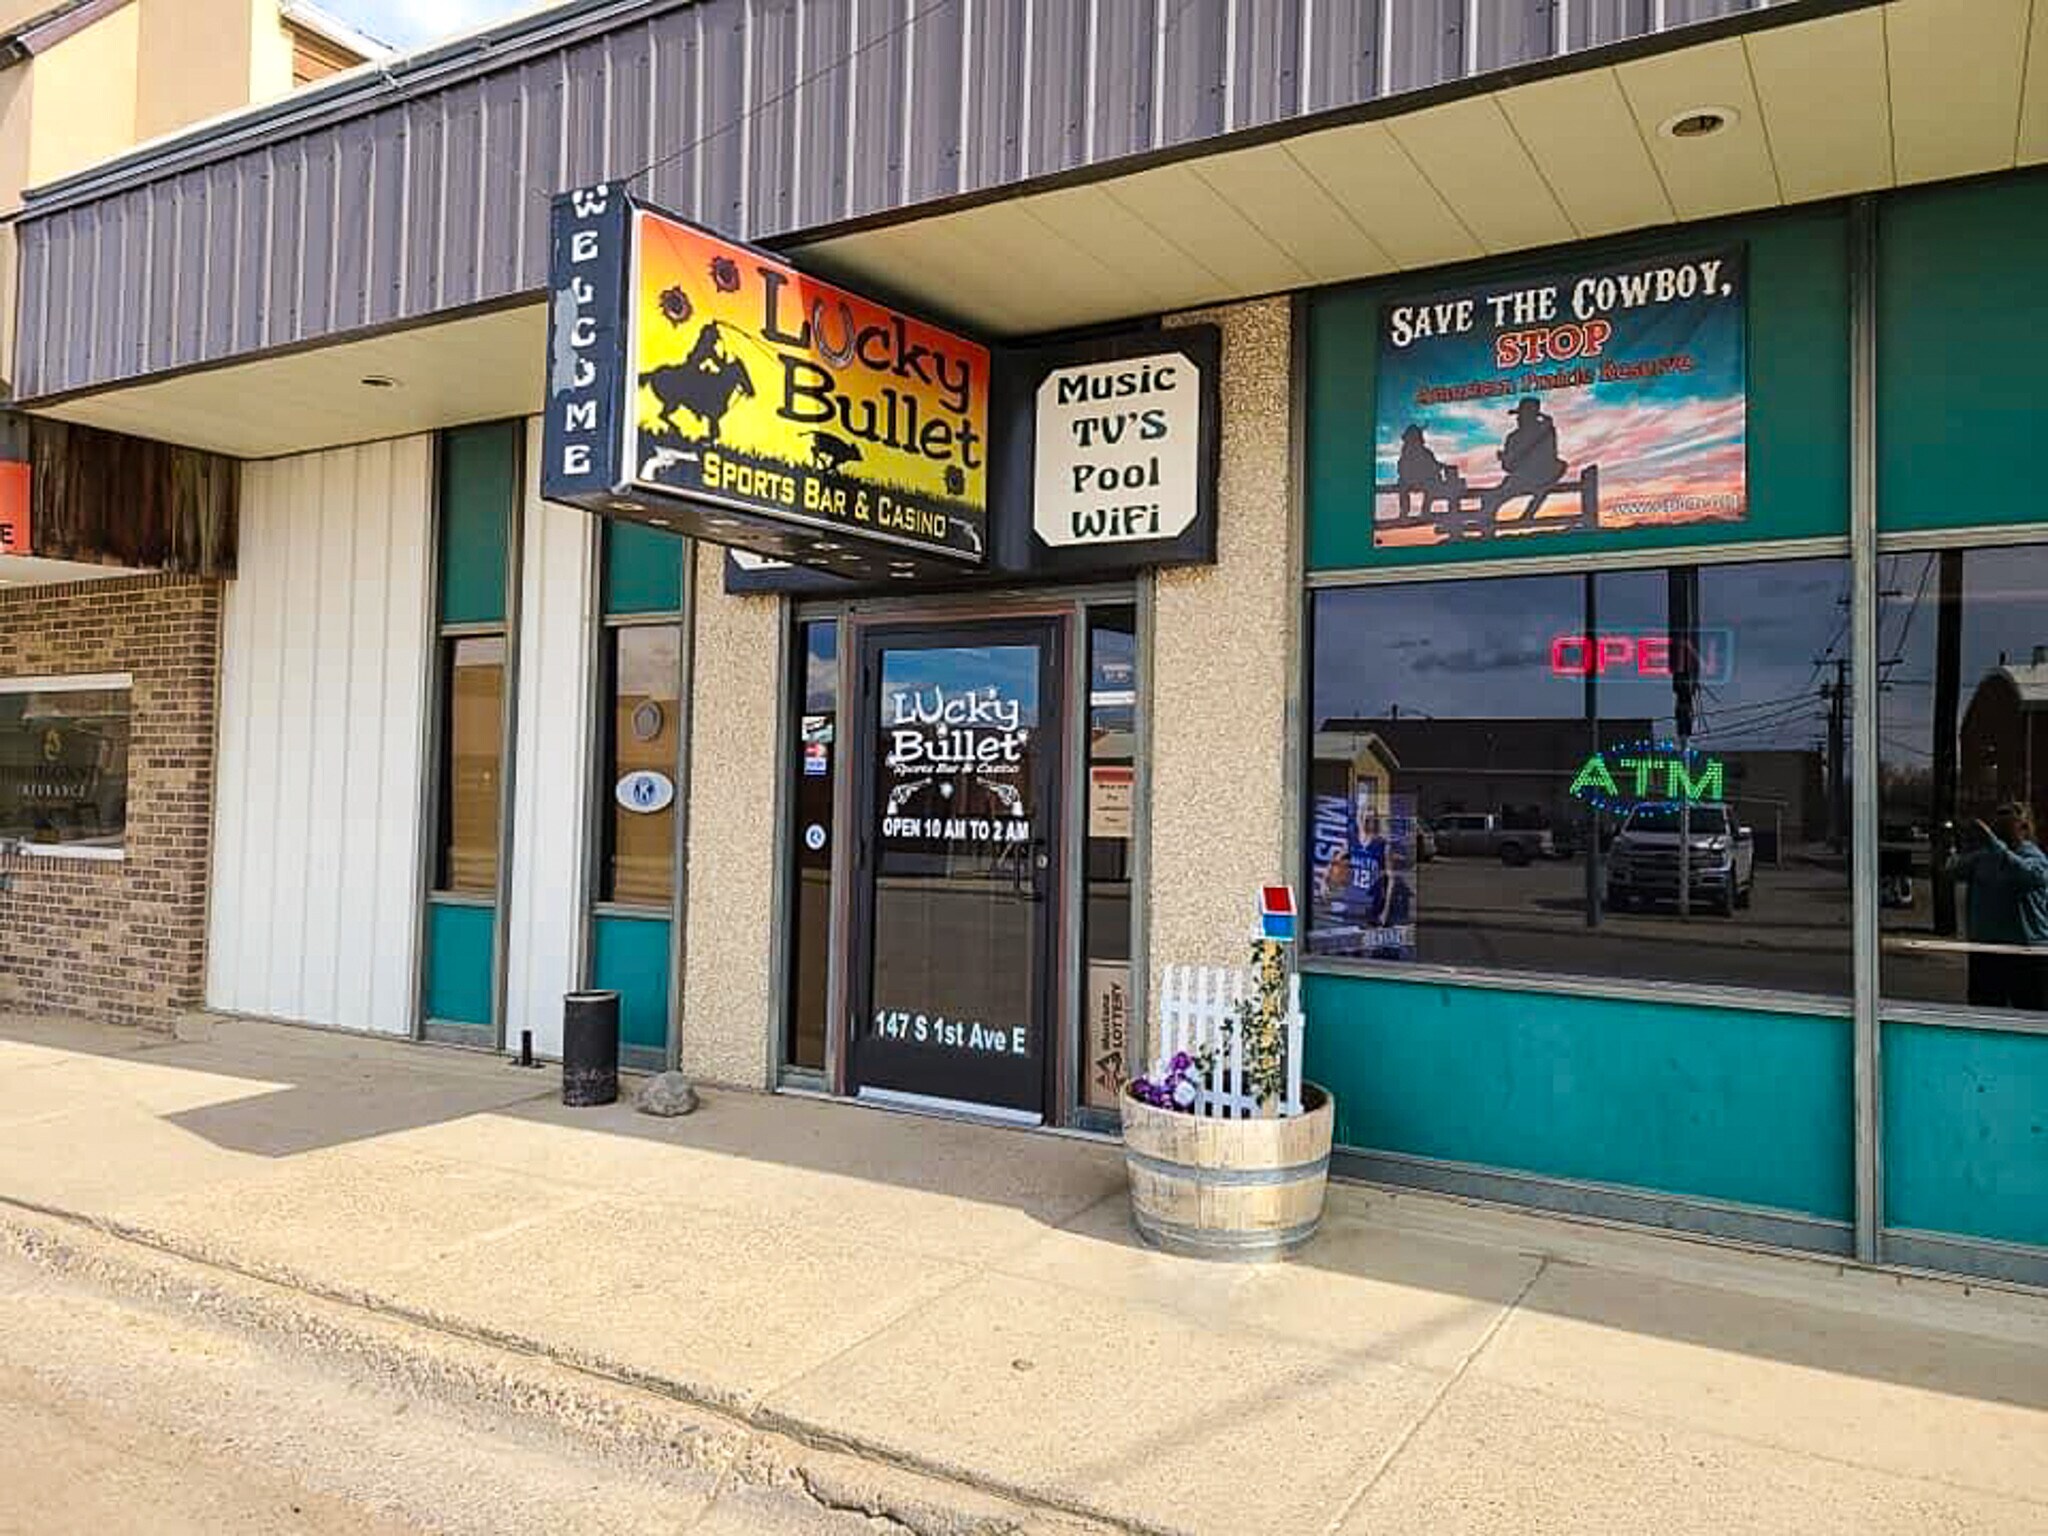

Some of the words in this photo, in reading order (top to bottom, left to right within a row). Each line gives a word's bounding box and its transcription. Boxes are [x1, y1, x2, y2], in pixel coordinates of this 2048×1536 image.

[1488, 288, 1556, 327] THE
[1497, 321, 1610, 367] STOP
[1058, 365, 1176, 404] Music
[775, 353, 982, 471] Bullet
[1072, 409, 1168, 447] TV'S
[1073, 456, 1160, 493] Pool
[854, 493, 870, 521] &
[1072, 504, 1160, 538] WiFi
[891, 728, 1021, 762] Bullet
[1569, 752, 1724, 800] ATM
[882, 817, 921, 838] OPEN
[924, 819, 942, 838] 10
[944, 820, 966, 839] AM
[969, 820, 990, 839] TO
[993, 820, 1003, 839] 2
[1005, 820, 1030, 840] AM
[875, 1010, 909, 1039] 147
[914, 1014, 928, 1041] S
[934, 1017, 965, 1047] 1st
[968, 1023, 1007, 1051] Ave
[1012, 1026, 1026, 1053] E
